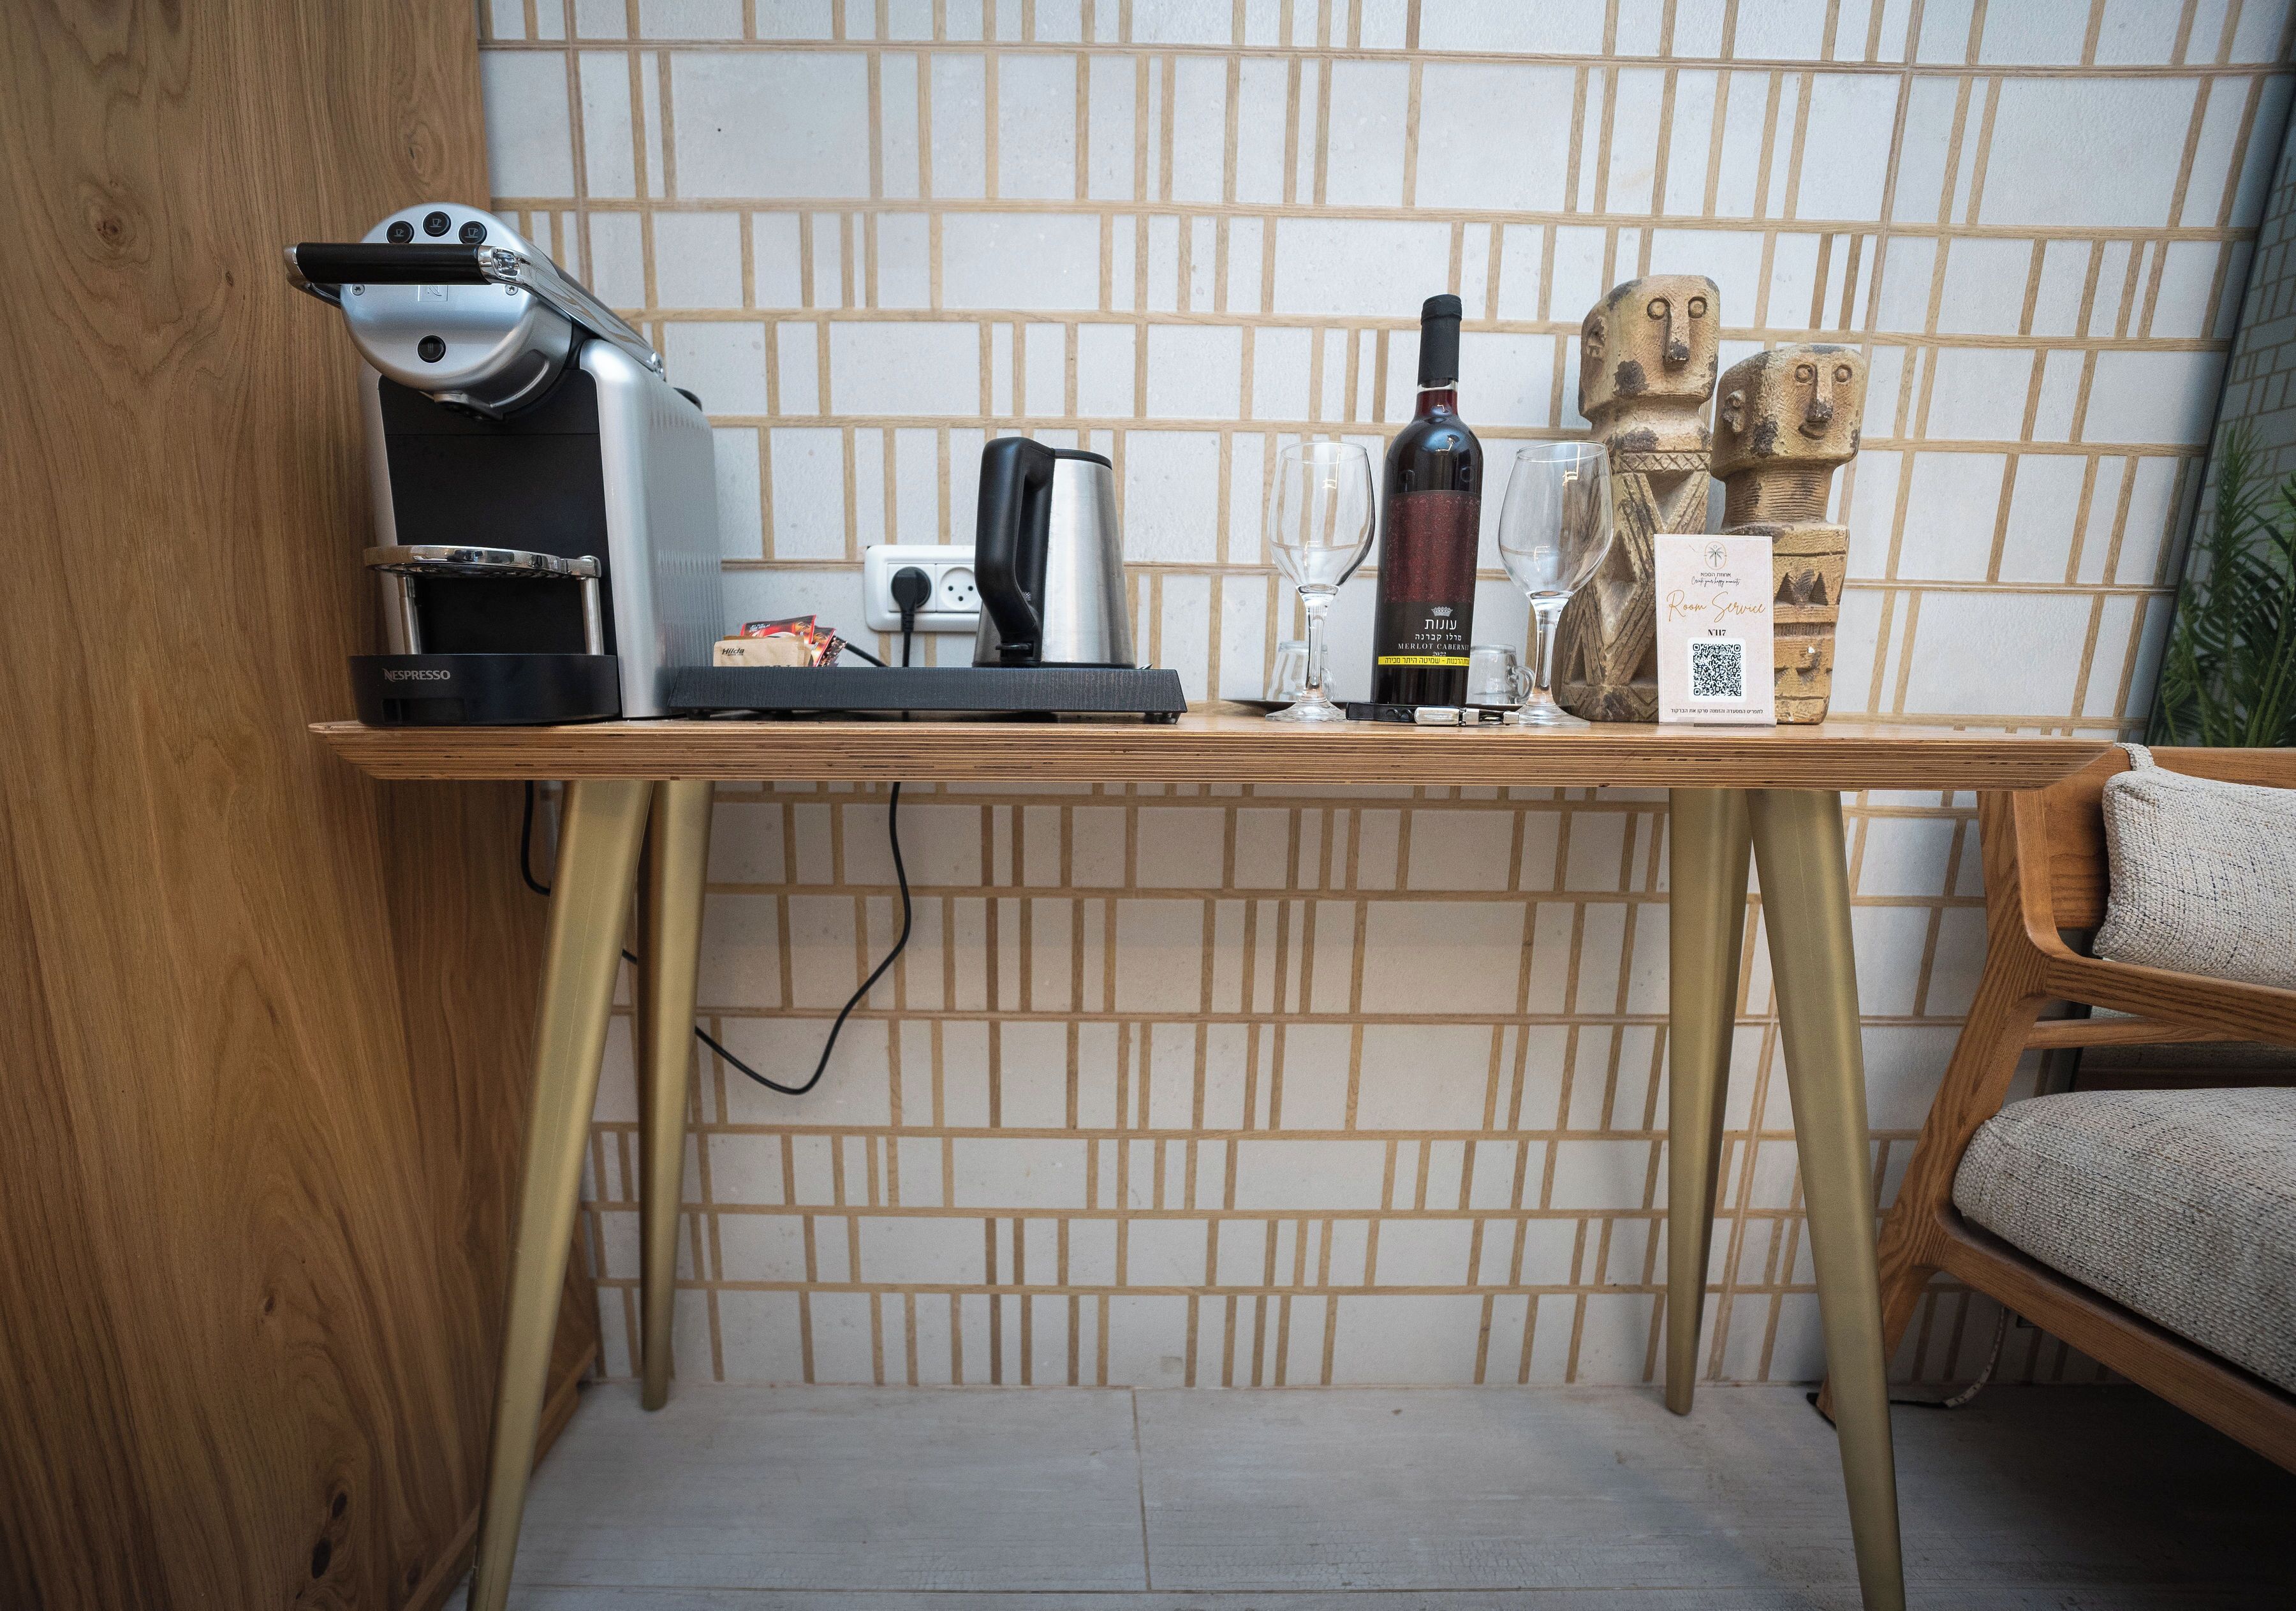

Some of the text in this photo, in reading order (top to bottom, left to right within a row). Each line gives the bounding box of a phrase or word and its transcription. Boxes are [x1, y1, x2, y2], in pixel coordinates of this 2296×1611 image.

[1714, 577, 1725, 587] happy
[1725, 578, 1742, 587] moments
[1666, 589, 1766, 623] Room Service
[1424, 619, 1457, 630] עונות
[1446, 633, 1462, 641] מרלו
[383, 668, 451, 682] NESPRESSO
